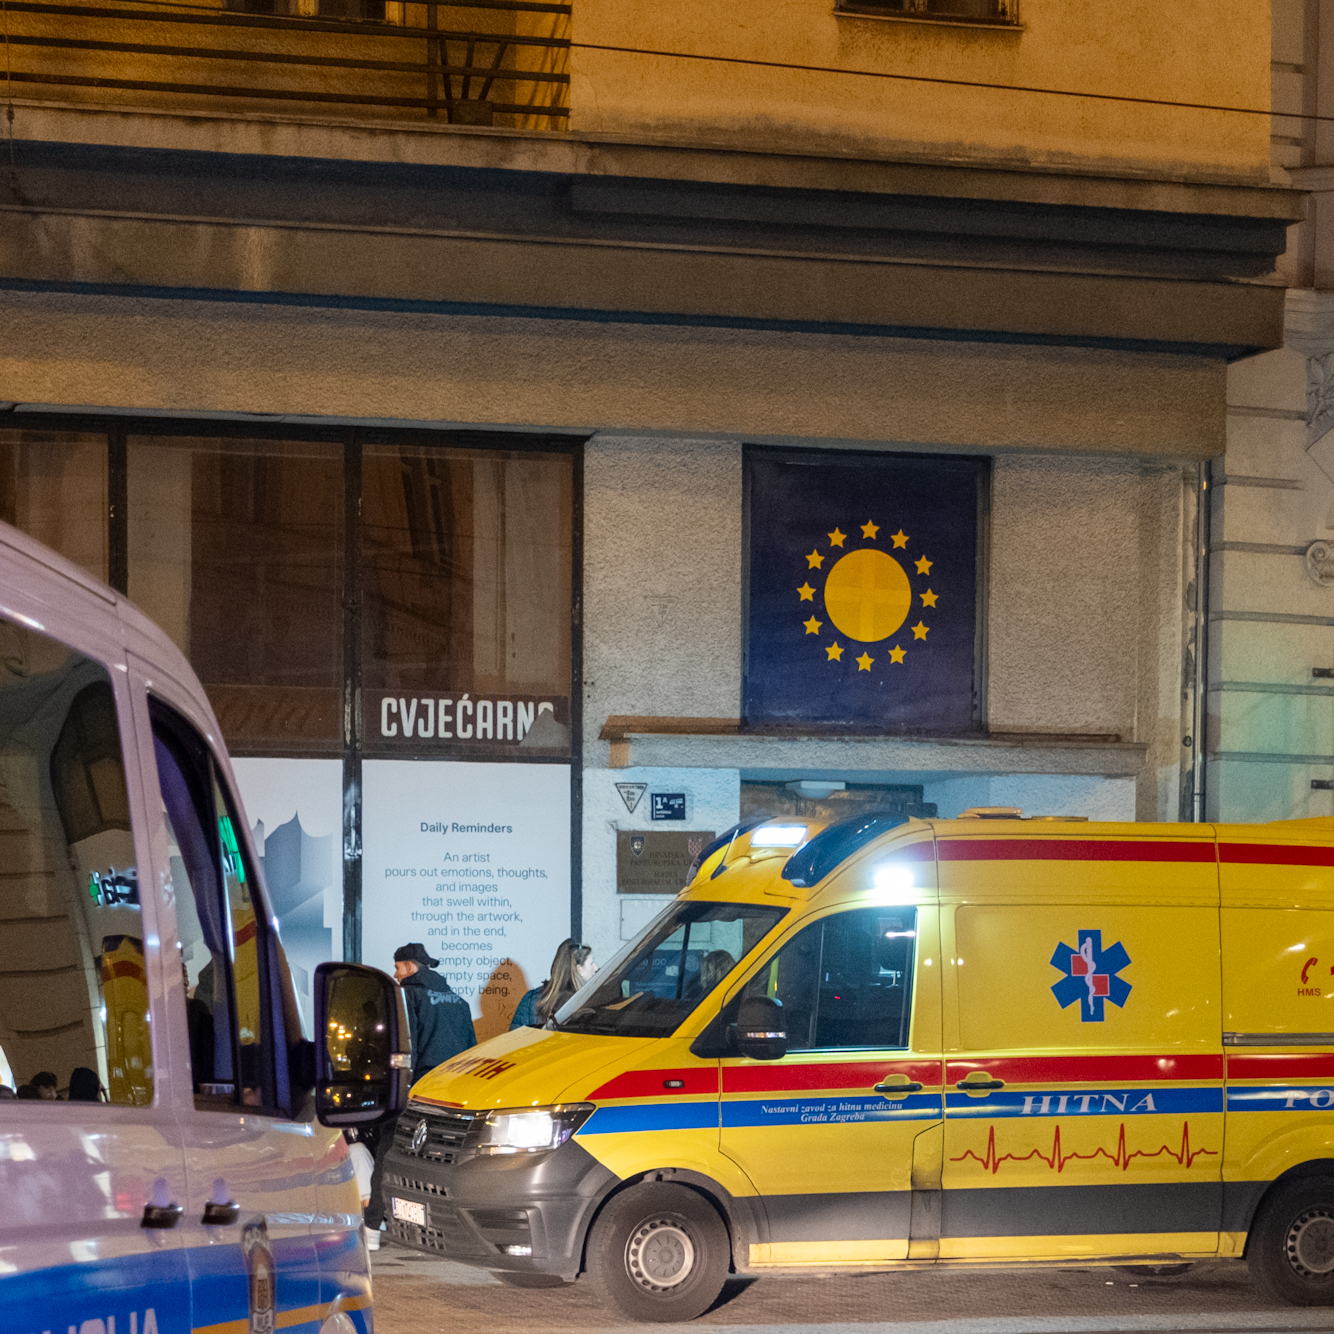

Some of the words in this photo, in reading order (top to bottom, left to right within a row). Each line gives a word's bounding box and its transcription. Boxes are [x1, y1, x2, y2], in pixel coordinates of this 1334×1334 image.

[420, 822, 449, 835] Daily
[451, 822, 513, 834] Reminders
[443, 852, 459, 863] An
[461, 852, 491, 863] artist
[384, 868, 417, 879] pours
[419, 867, 438, 877] out
[440, 867, 495, 879] emotions,
[497, 867, 548, 880] thoughts,
[435, 882, 456, 892] and
[458, 882, 498, 894] images
[422, 896, 443, 907] that
[446, 896, 474, 907] swell
[477, 896, 512, 908] within,
[411, 911, 454, 923] through
[456, 911, 474, 922] the
[477, 911, 523, 923] artwork,
[427, 926, 448, 936] and
[450, 926, 460, 936] in
[462, 926, 481, 936] the
[483, 926, 506, 938] end,
[441, 940, 493, 951] becomes
[439, 957, 473, 968] empty
[475, 956, 513, 968] object,
[476, 972, 512, 983] space,
[478, 985, 511, 997] being.
[1297, 987, 1321, 997] HMS
[760, 1103, 799, 1114] Nastavni
[801, 1103, 826, 1113] zavod
[827, 1105, 837, 1113] za
[839, 1102, 862, 1112] hitnu
[863, 1101, 903, 1111] medicinu
[1019, 1093, 1158, 1115] HITNA
[800, 1113, 828, 1123] Grada
[829, 1112, 865, 1123] Zagreba
